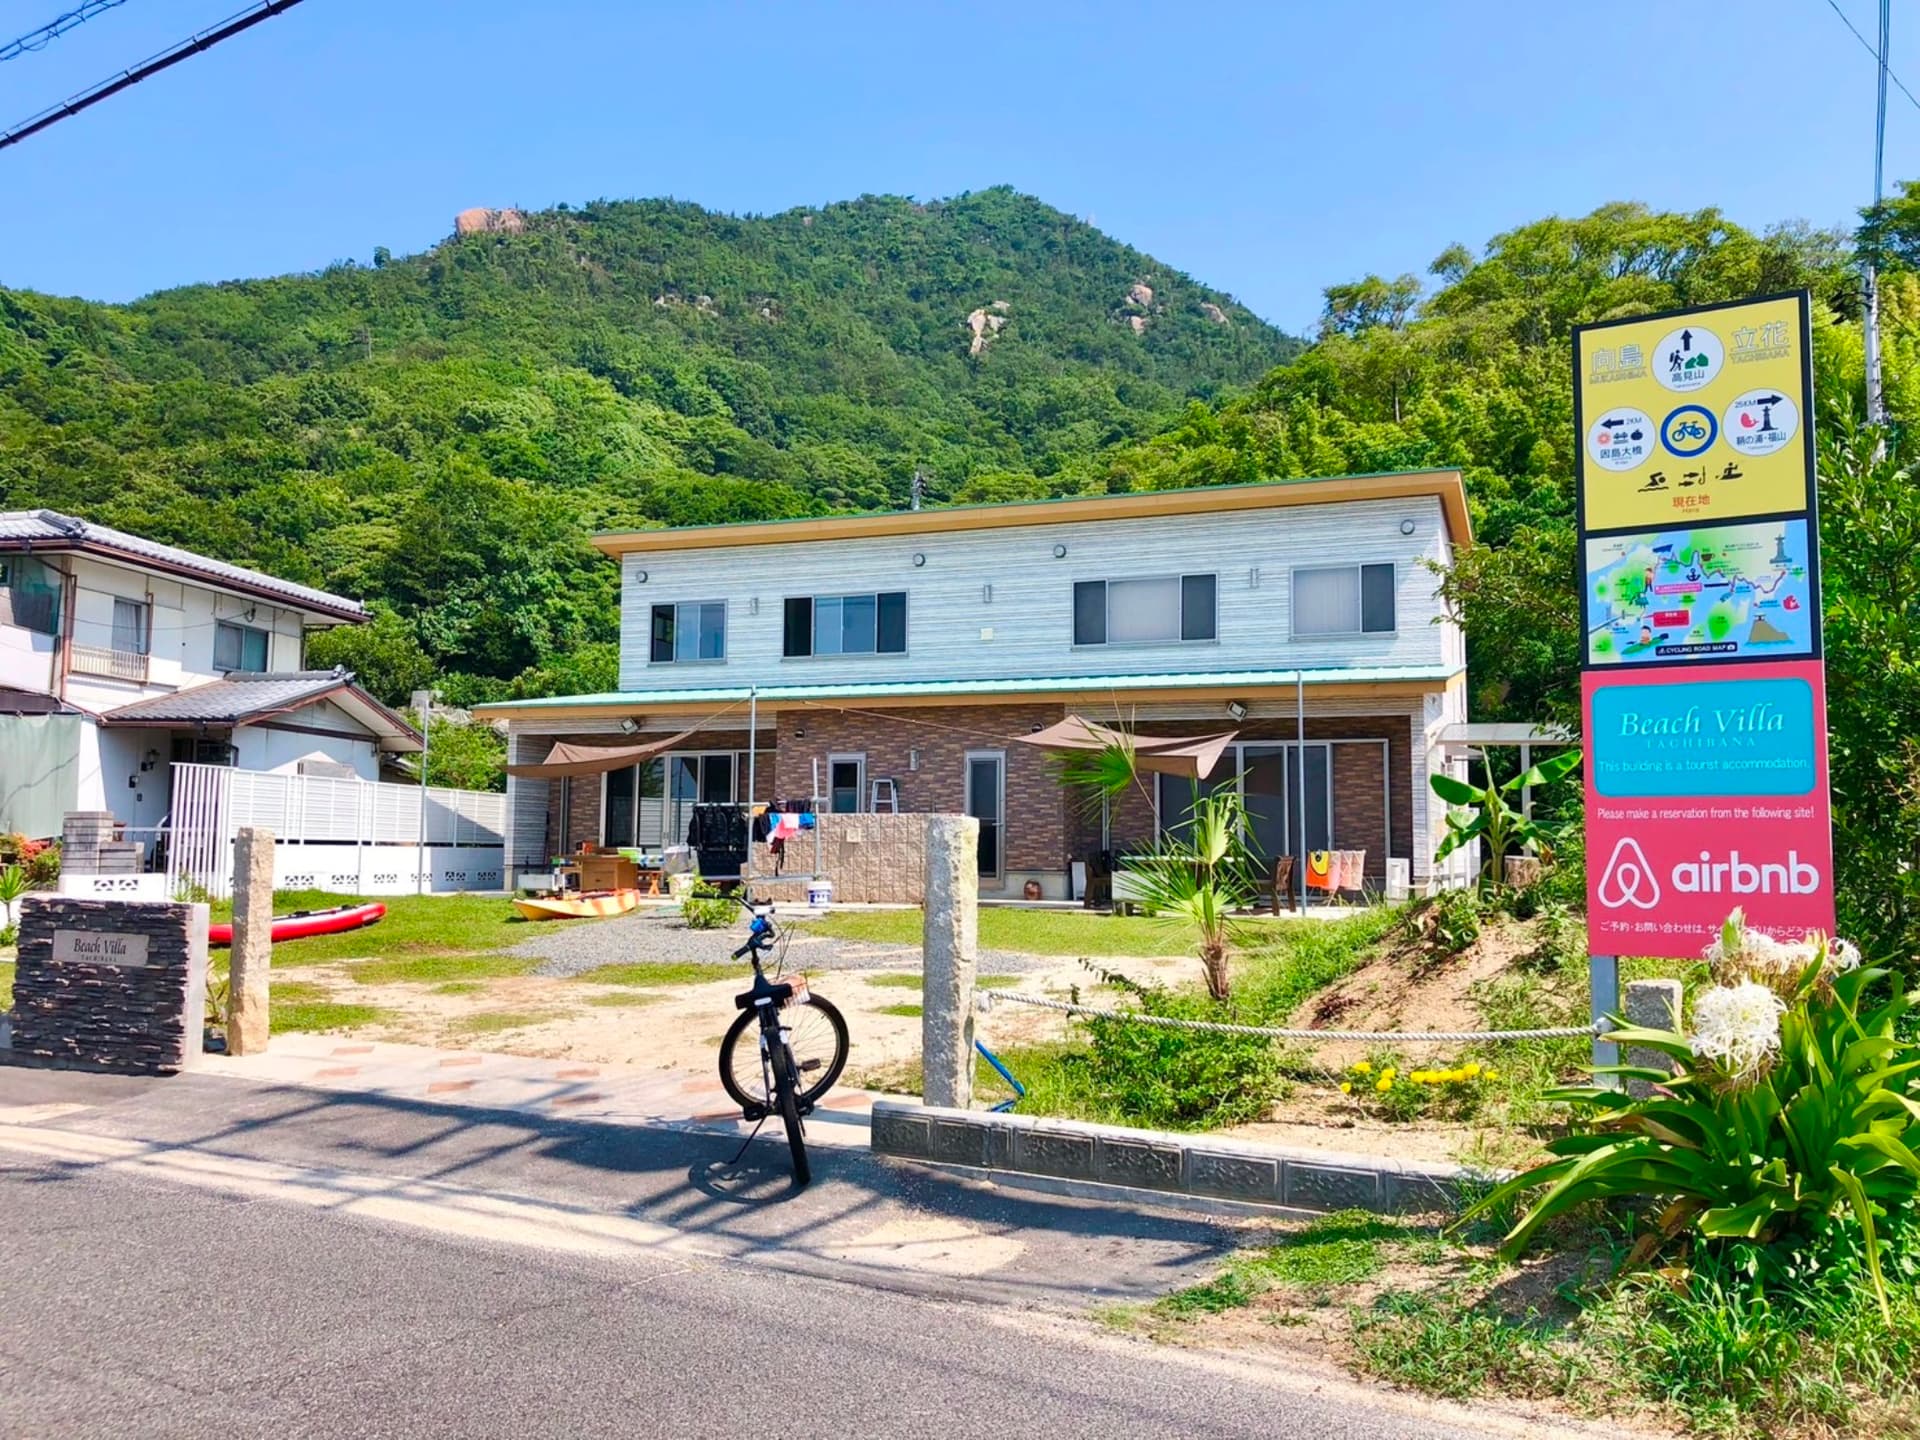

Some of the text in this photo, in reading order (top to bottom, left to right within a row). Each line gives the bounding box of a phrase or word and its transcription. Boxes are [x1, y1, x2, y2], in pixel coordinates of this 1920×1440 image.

[1731, 320, 1789, 352] 立花
[1592, 344, 1643, 374] 向島
[1672, 369, 1705, 383] 高見山
[1672, 494, 1711, 508] 現在地
[1666, 643, 1727, 655] CYCLING ROAD MAP
[1618, 703, 1784, 736] Beach Villa
[1647, 737, 1756, 749] TACHIBANA
[1599, 760, 1620, 772] This
[1623, 759, 1663, 773] building
[1665, 760, 1673, 771] is
[1676, 762, 1683, 770] a
[1686, 759, 1719, 771] tourist
[1597, 805, 1815, 820] Please make a reservation from the following site!
[1672, 850, 1820, 895] airbnb
[73, 937, 127, 955] Beach Villa
